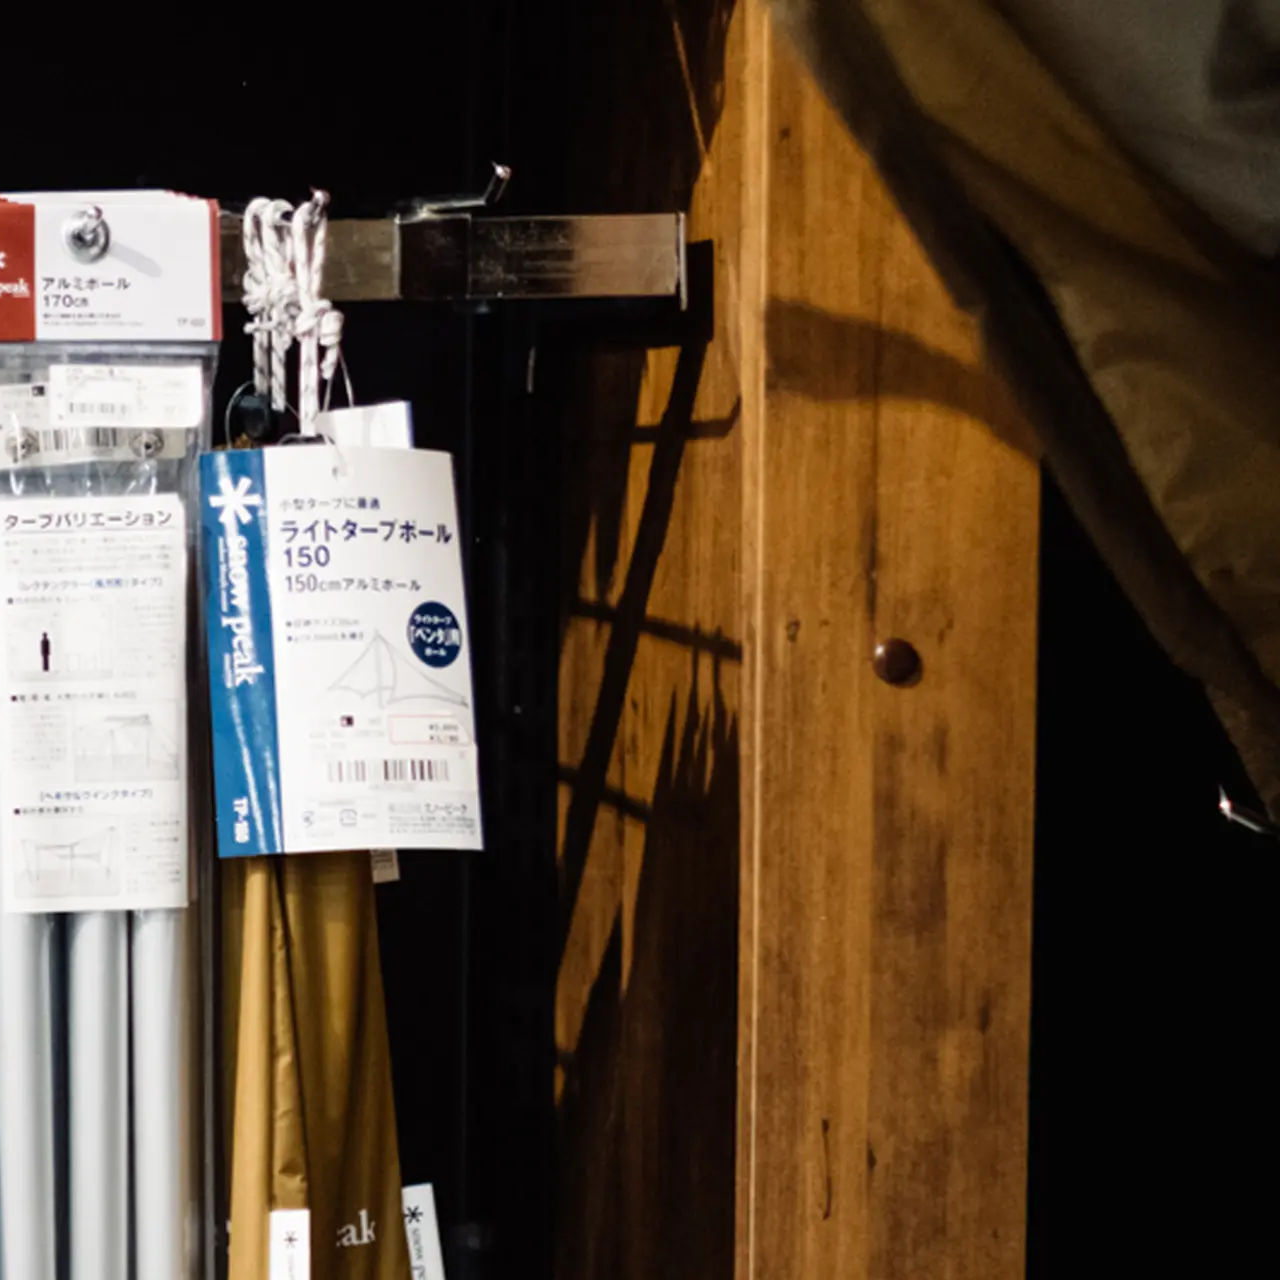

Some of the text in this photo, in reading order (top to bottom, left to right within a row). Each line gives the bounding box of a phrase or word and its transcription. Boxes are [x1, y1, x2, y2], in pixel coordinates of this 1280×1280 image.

[284, 545, 331, 568] 150
[221, 614, 265, 688] peak
[336, 1209, 376, 1247] ak
